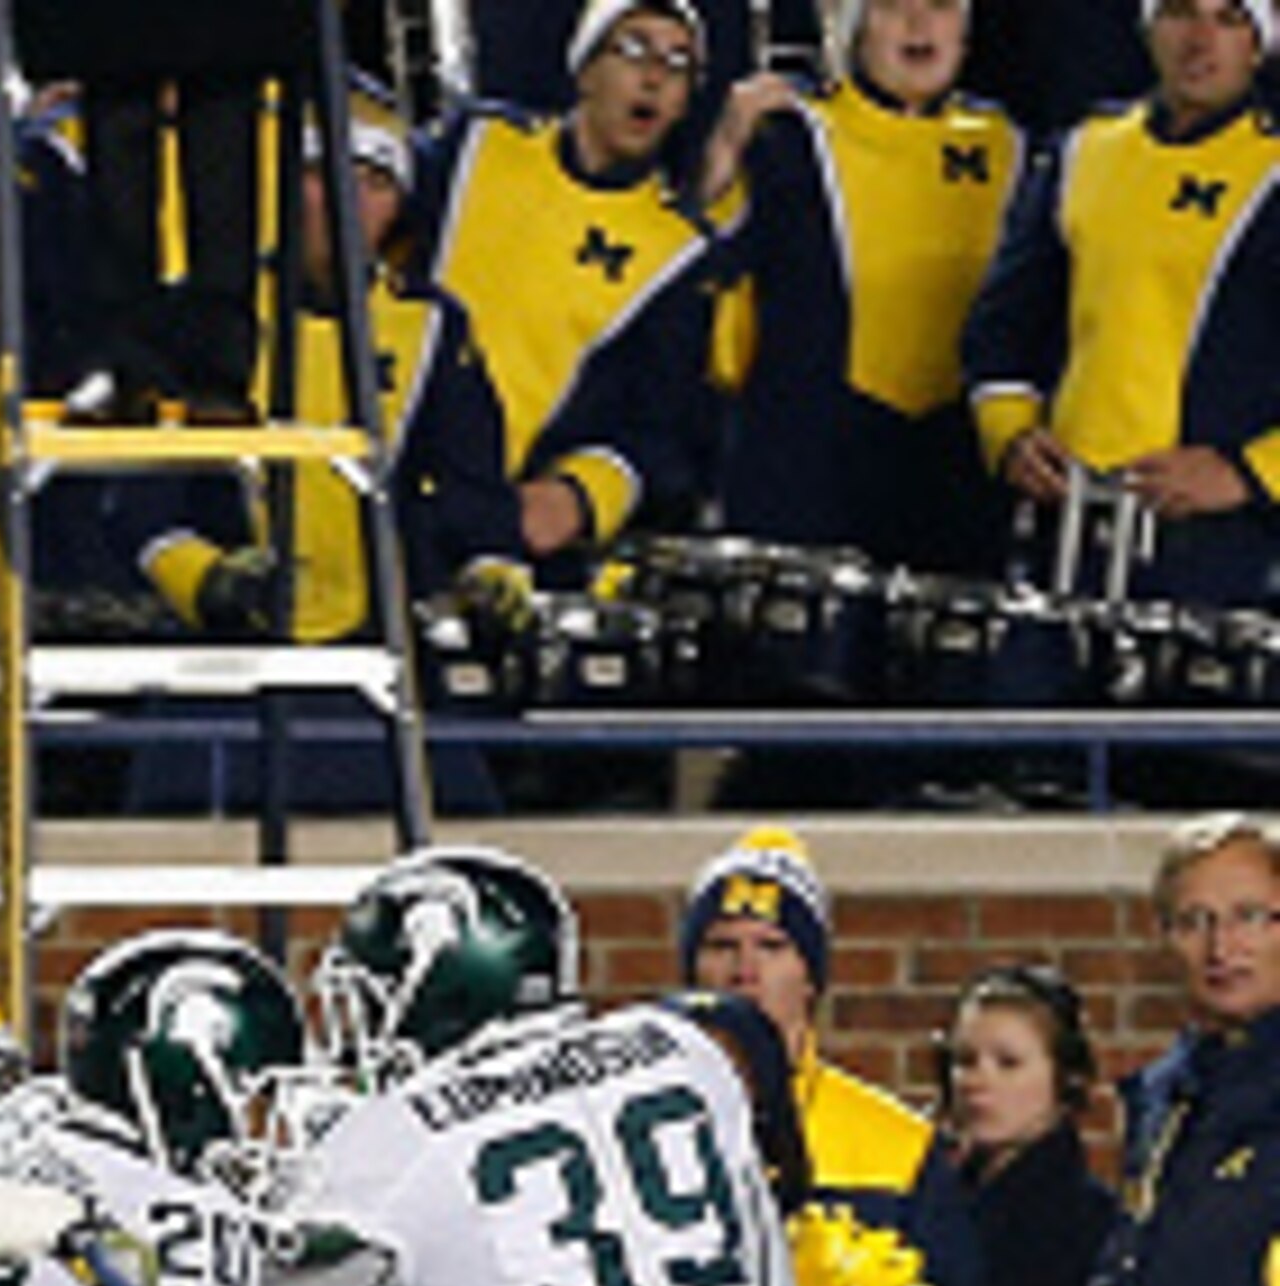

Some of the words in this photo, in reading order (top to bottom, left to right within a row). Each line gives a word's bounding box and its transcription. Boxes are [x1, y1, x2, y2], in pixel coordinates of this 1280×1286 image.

[942, 144, 990, 184] M
[1168, 174, 1229, 217] M
[574, 226, 635, 282] M
[720, 871, 784, 922] M
